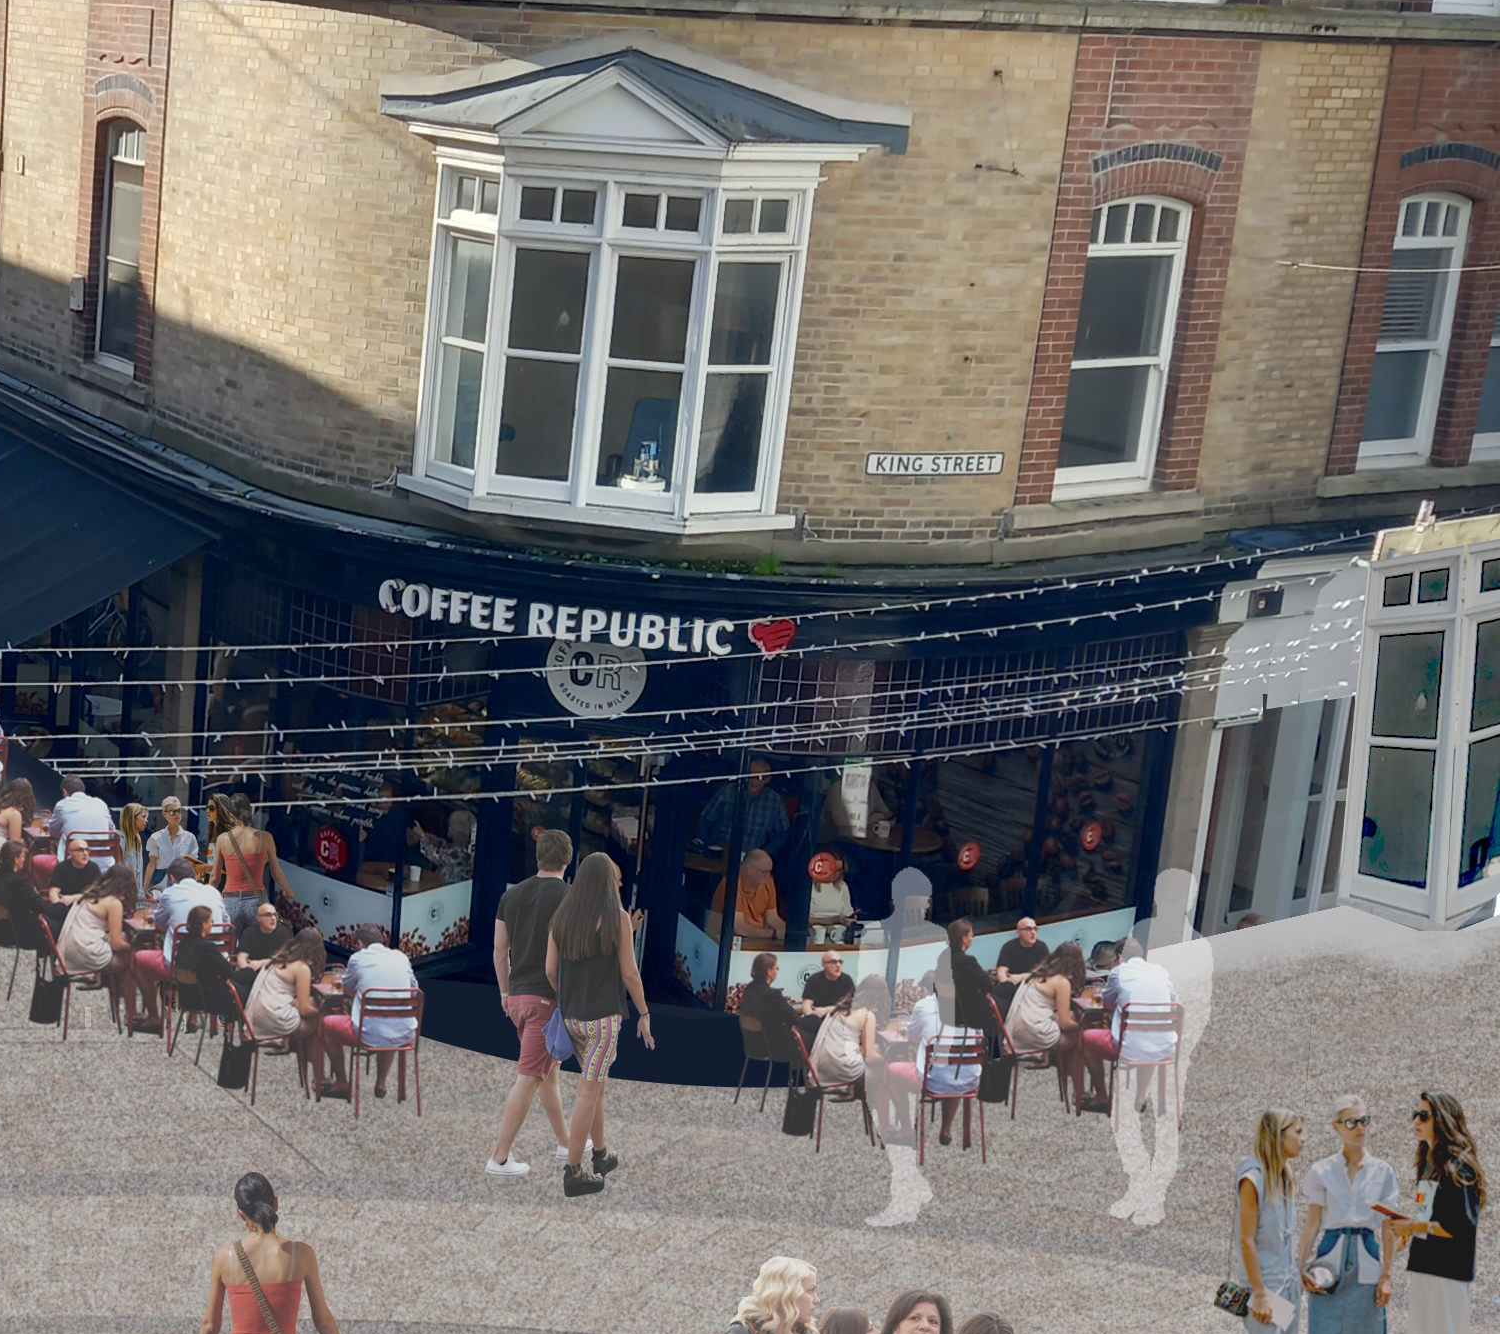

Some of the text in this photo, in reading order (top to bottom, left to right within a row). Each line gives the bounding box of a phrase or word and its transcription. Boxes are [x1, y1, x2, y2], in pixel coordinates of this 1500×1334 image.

[875, 455, 997, 473] KING STREET
[378, 578, 736, 656] COFFEE REPUBLIC
[569, 650, 622, 691] CR
[606, 688, 631, 709] MILAN
